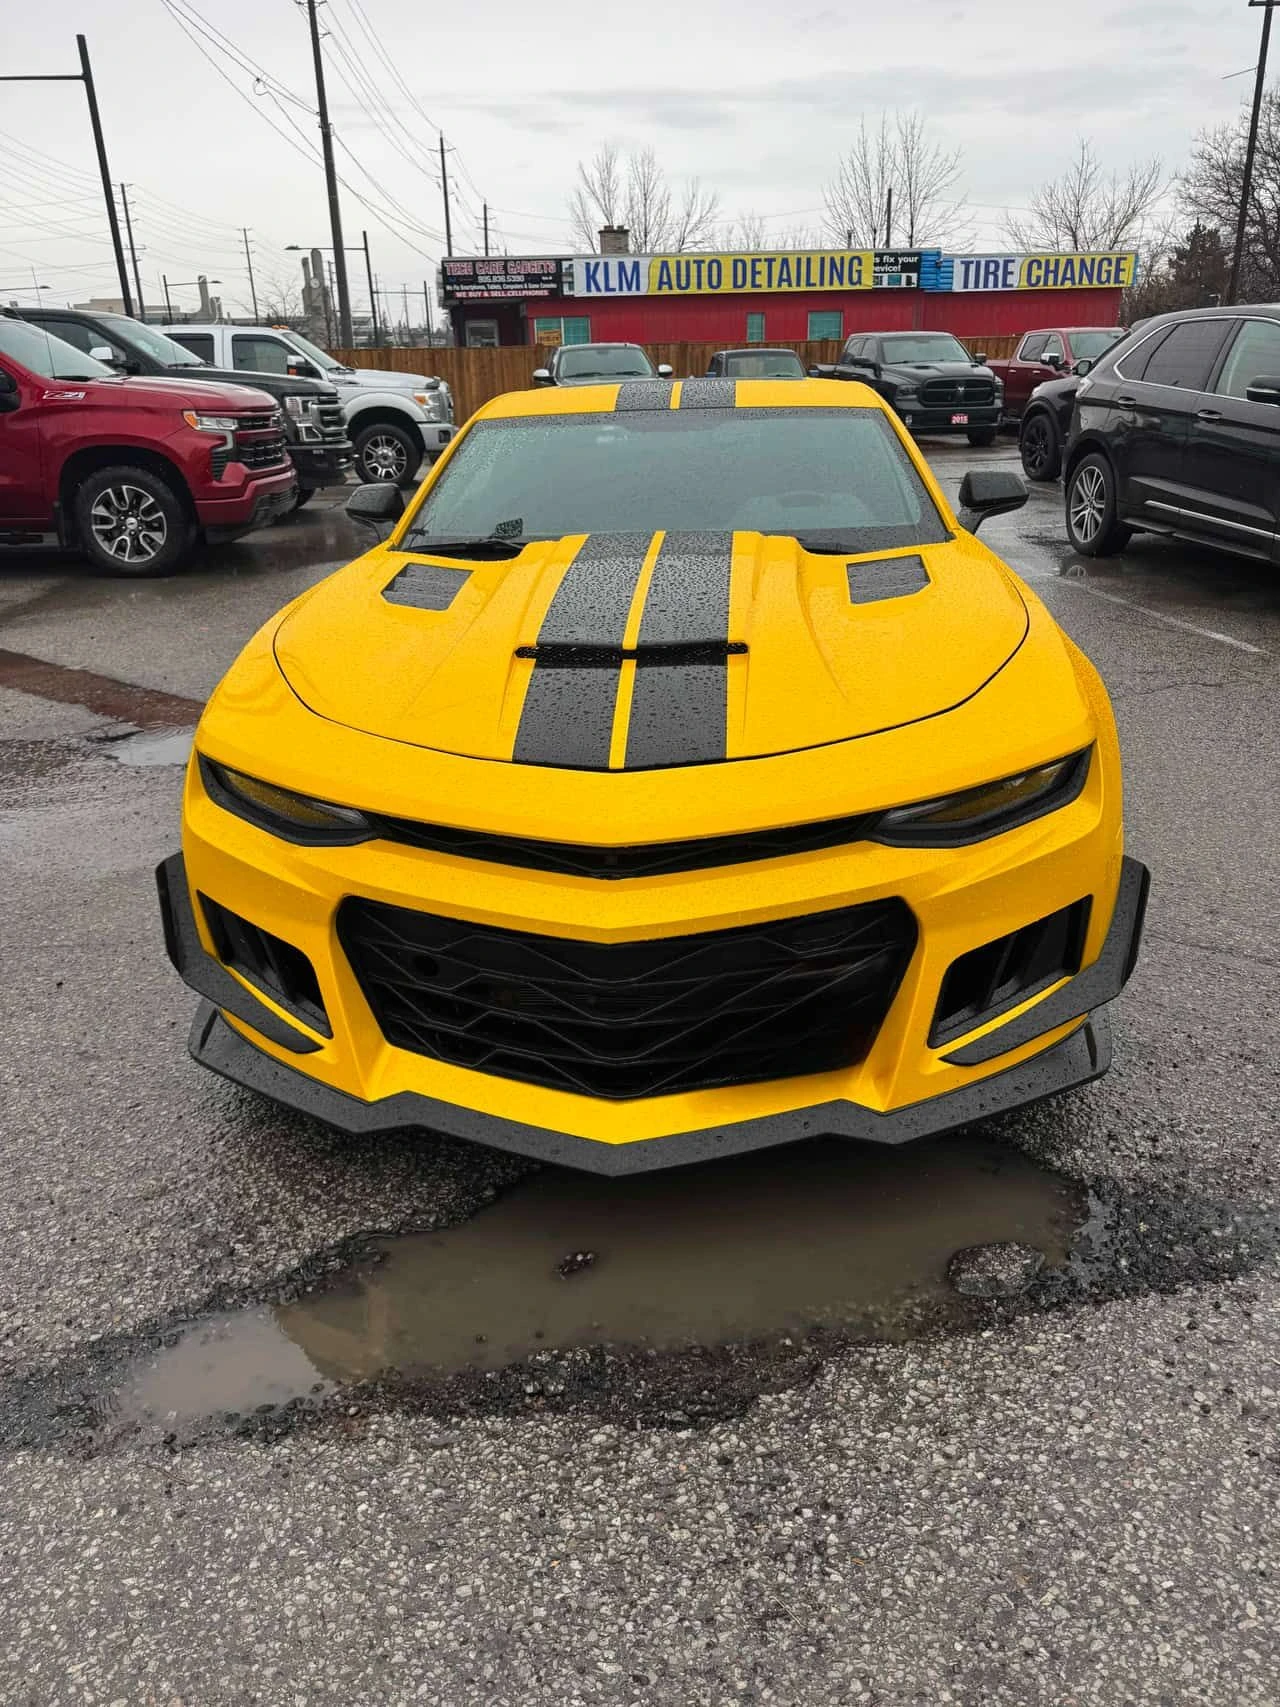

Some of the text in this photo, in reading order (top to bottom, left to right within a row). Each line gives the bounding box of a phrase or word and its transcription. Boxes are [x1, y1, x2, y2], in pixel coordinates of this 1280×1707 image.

[584, 256, 862, 292] KLM AUTO DETAILING
[883, 255, 895, 263] fix
[898, 256, 919, 265] your
[961, 257, 1127, 289] TIRE CHANGE
